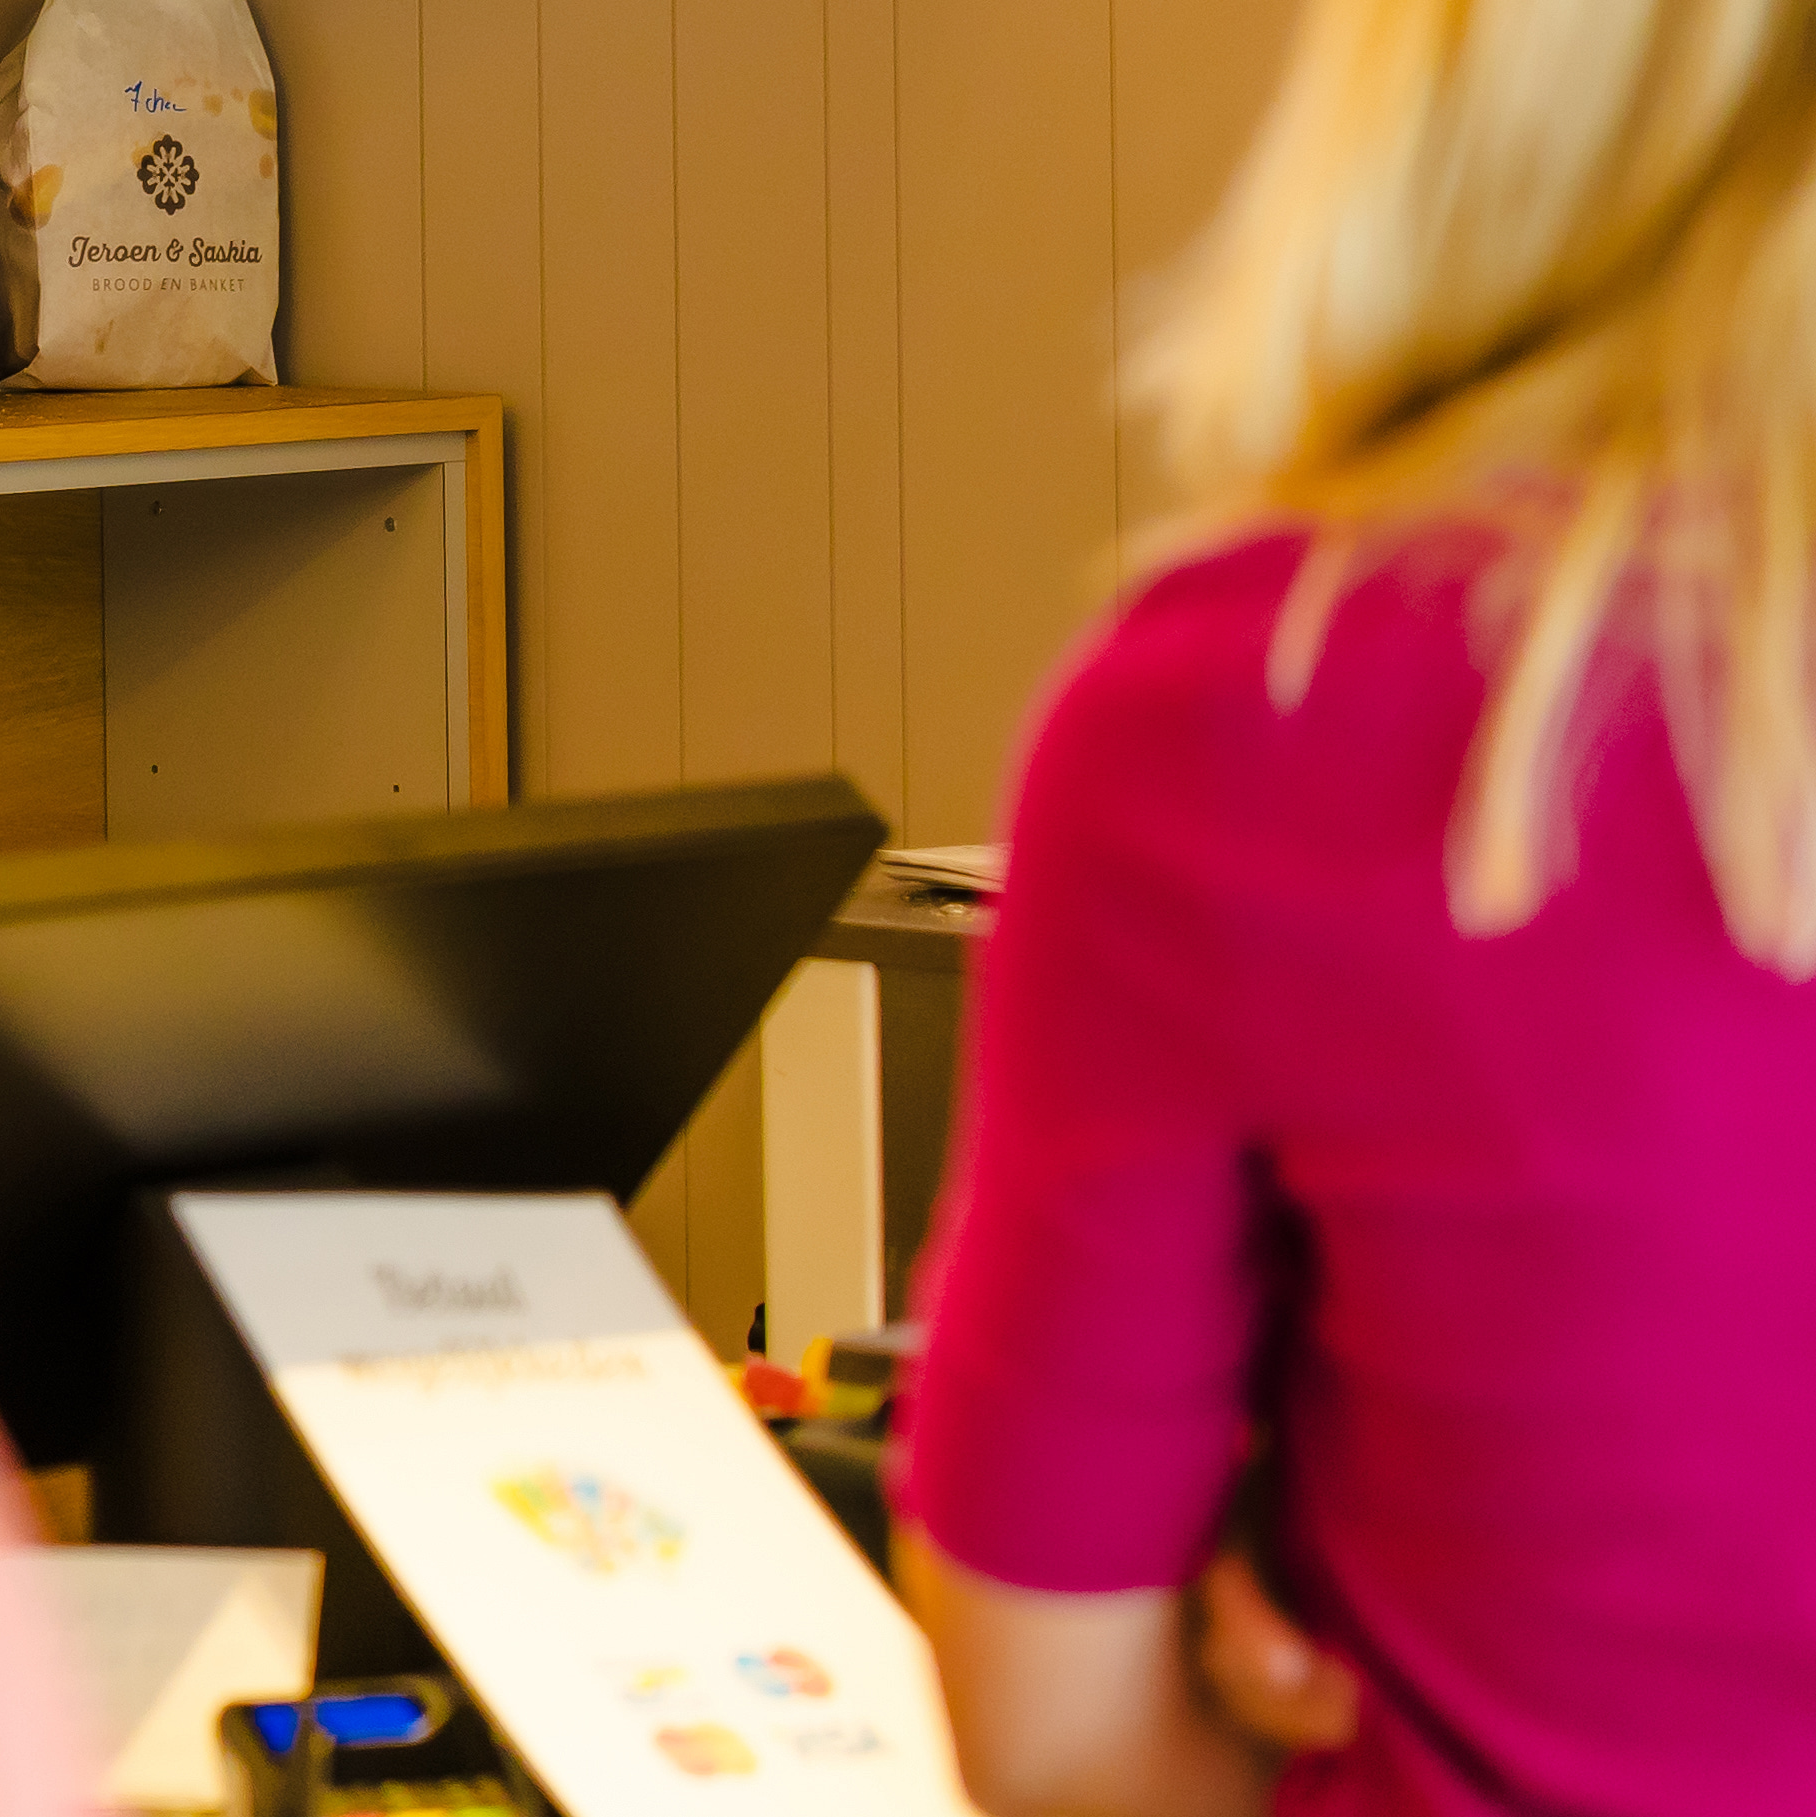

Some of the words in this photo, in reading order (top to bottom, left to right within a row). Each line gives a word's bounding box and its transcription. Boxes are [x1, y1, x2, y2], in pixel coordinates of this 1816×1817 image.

[124, 81, 143, 112] 7
[68, 236, 161, 267] Jeroen
[166, 238, 184, 262] &
[188, 237, 263, 267] Saskia
[92, 278, 152, 291] BROOD
[160, 277, 182, 291] EN
[190, 278, 244, 292] BANKET
